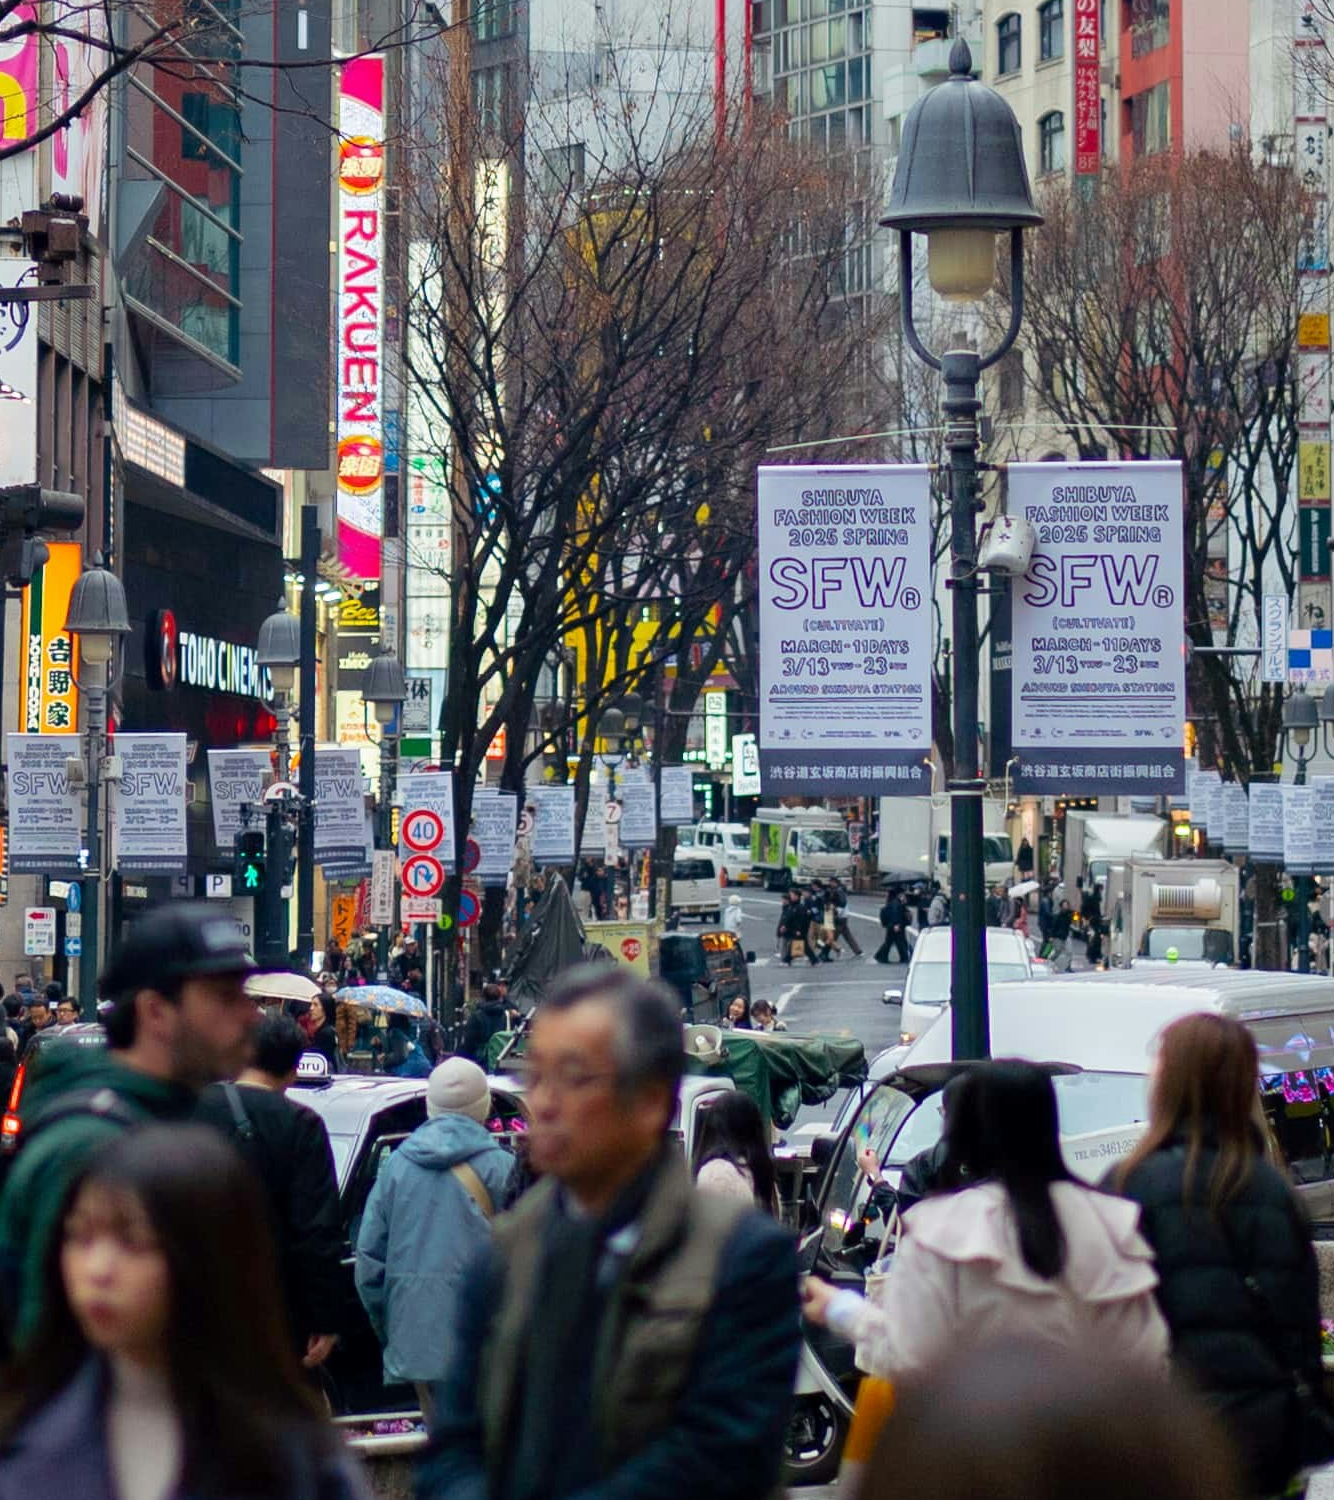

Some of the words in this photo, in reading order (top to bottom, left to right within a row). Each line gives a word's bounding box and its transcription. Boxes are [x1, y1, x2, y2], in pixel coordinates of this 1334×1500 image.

[344, 209, 379, 423] RAKUEN
[801, 488, 885, 507] SHIBUYA
[1051, 485, 1137, 504] SHIBUYA
[773, 508, 857, 527] FASHION
[859, 506, 917, 525] WEEK
[1025, 505, 1108, 523] FASHION
[1111, 504, 1170, 522] WEEK
[788, 528, 839, 547] 2025
[842, 528, 910, 546] SPRING
[1039, 525, 1088, 544] 2025
[1093, 525, 1162, 543] SPRING
[338, 599, 378, 620] Bee
[179, 631, 216, 690] TOHO
[47, 635, 71, 728] 吉野家
[411, 821, 436, 840] 40
[212, 876, 224, 891] P
